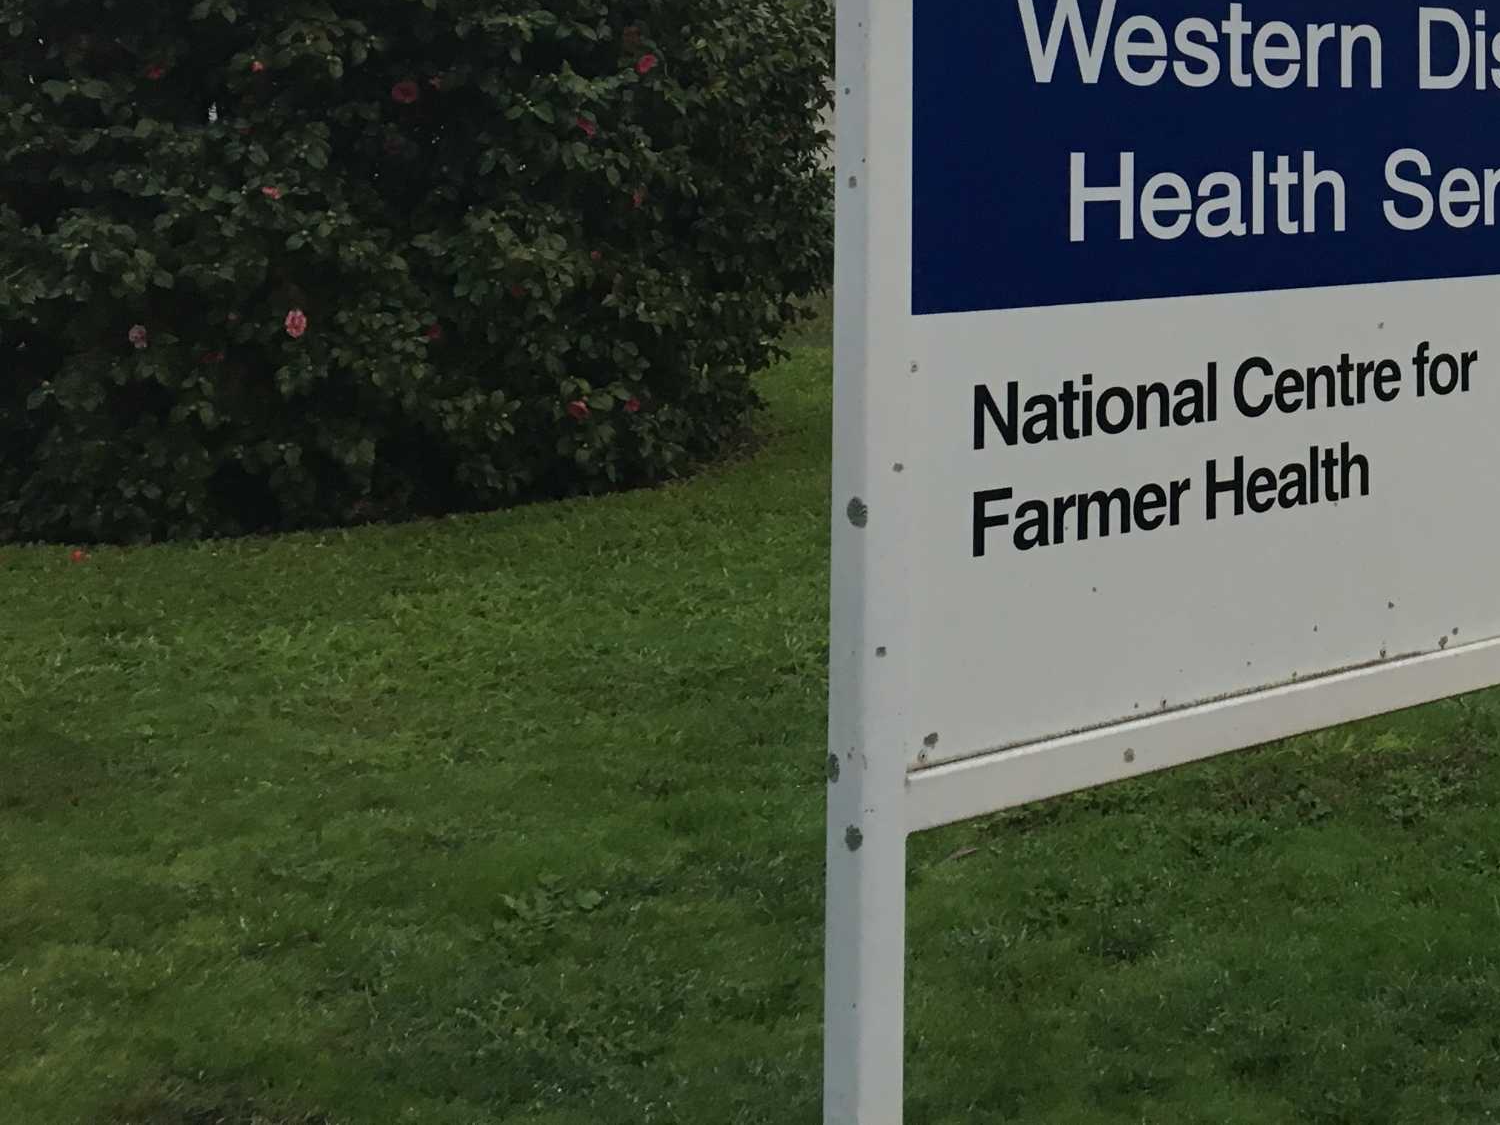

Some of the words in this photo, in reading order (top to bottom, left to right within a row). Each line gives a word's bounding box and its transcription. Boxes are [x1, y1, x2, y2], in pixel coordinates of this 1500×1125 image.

[1069, 150, 1346, 242] Health
[973, 361, 1217, 451] National
[1233, 353, 1402, 418] Centre
[1411, 340, 1478, 398] for
[972, 477, 1191, 558] Farmer
[1205, 441, 1370, 521] Health
